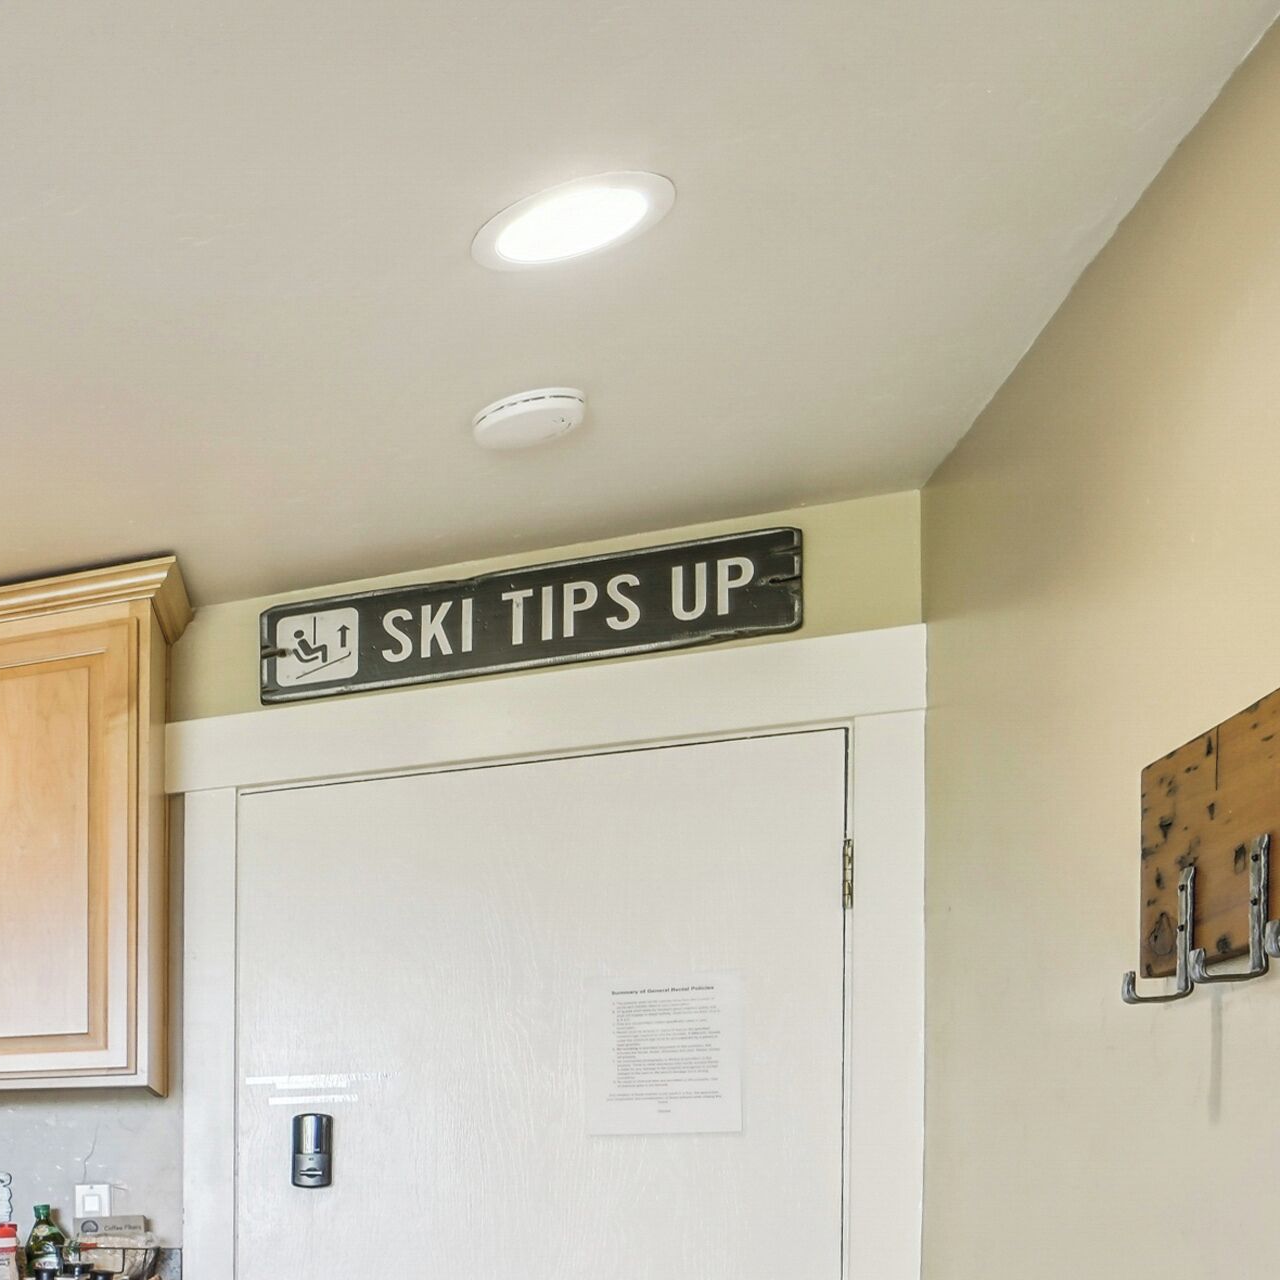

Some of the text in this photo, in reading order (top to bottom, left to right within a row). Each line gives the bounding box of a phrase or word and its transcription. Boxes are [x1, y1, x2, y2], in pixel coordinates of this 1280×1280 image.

[381, 555, 756, 664] SKI TIPS UP
